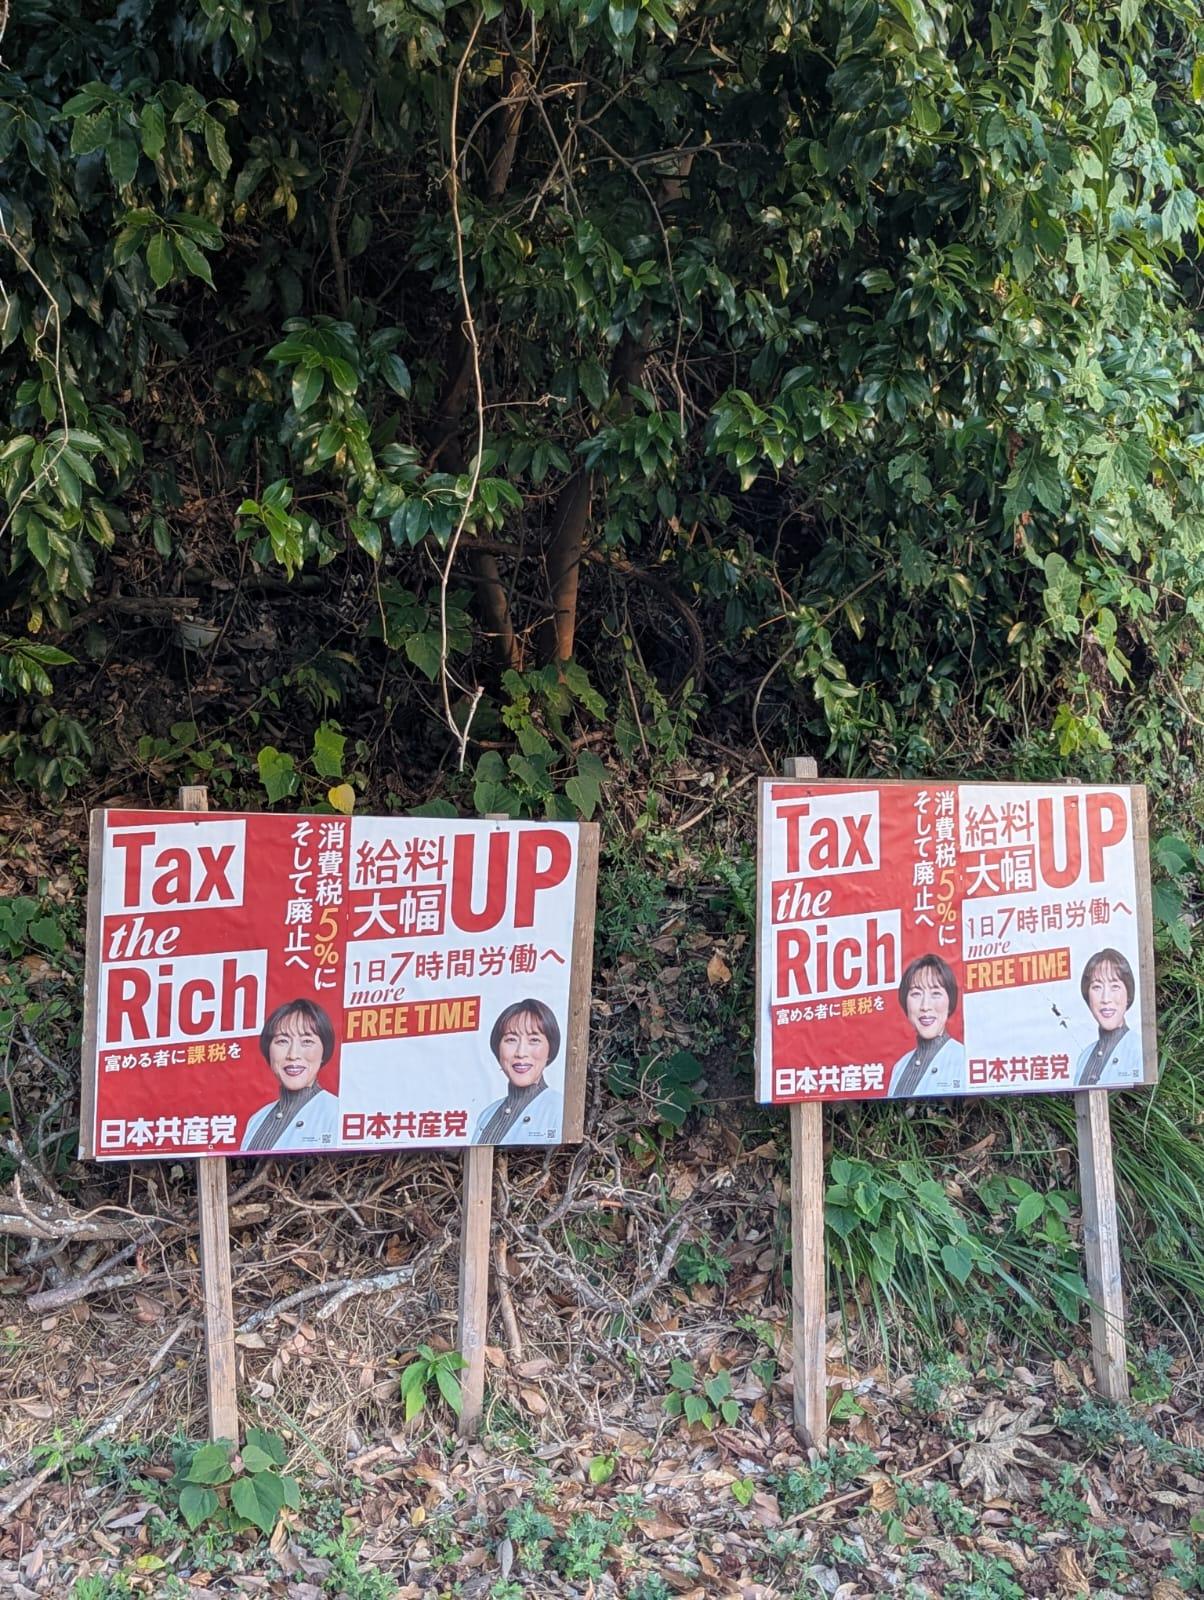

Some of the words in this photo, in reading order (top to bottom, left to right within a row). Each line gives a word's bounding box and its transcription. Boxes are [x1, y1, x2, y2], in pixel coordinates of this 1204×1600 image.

[776, 803, 874, 873] Tax
[964, 800, 1035, 847] 給料
[1037, 792, 1128, 889] UP
[112, 831, 236, 908] Tax
[355, 835, 449, 886] 給料
[450, 829, 572, 933] UP
[912, 790, 935, 927] そして廃止へ
[965, 849, 1033, 896] 大幅
[284, 820, 313, 970] そして廃止へ
[352, 889, 442, 938] 大幅
[776, 881, 832, 921] the
[108, 916, 181, 960] the
[776, 918, 896, 999] Rich
[967, 940, 1011, 959] more
[966, 958, 1016, 990] FREE
[1019, 951, 1070, 982] TIME
[106, 958, 259, 1044] Rich
[350, 986, 405, 1005] more
[776, 995, 885, 1025] 富める者に課税を
[346, 1006, 409, 1040] FREE
[414, 1000, 477, 1033] TIME
[104, 1042, 242, 1073] 富める者に課税を
[775, 1063, 884, 1096] 日本共産党
[969, 1054, 1070, 1084] 日本共産党
[100, 1114, 237, 1149] 日本共産党
[342, 1110, 468, 1141] 日本共産党
